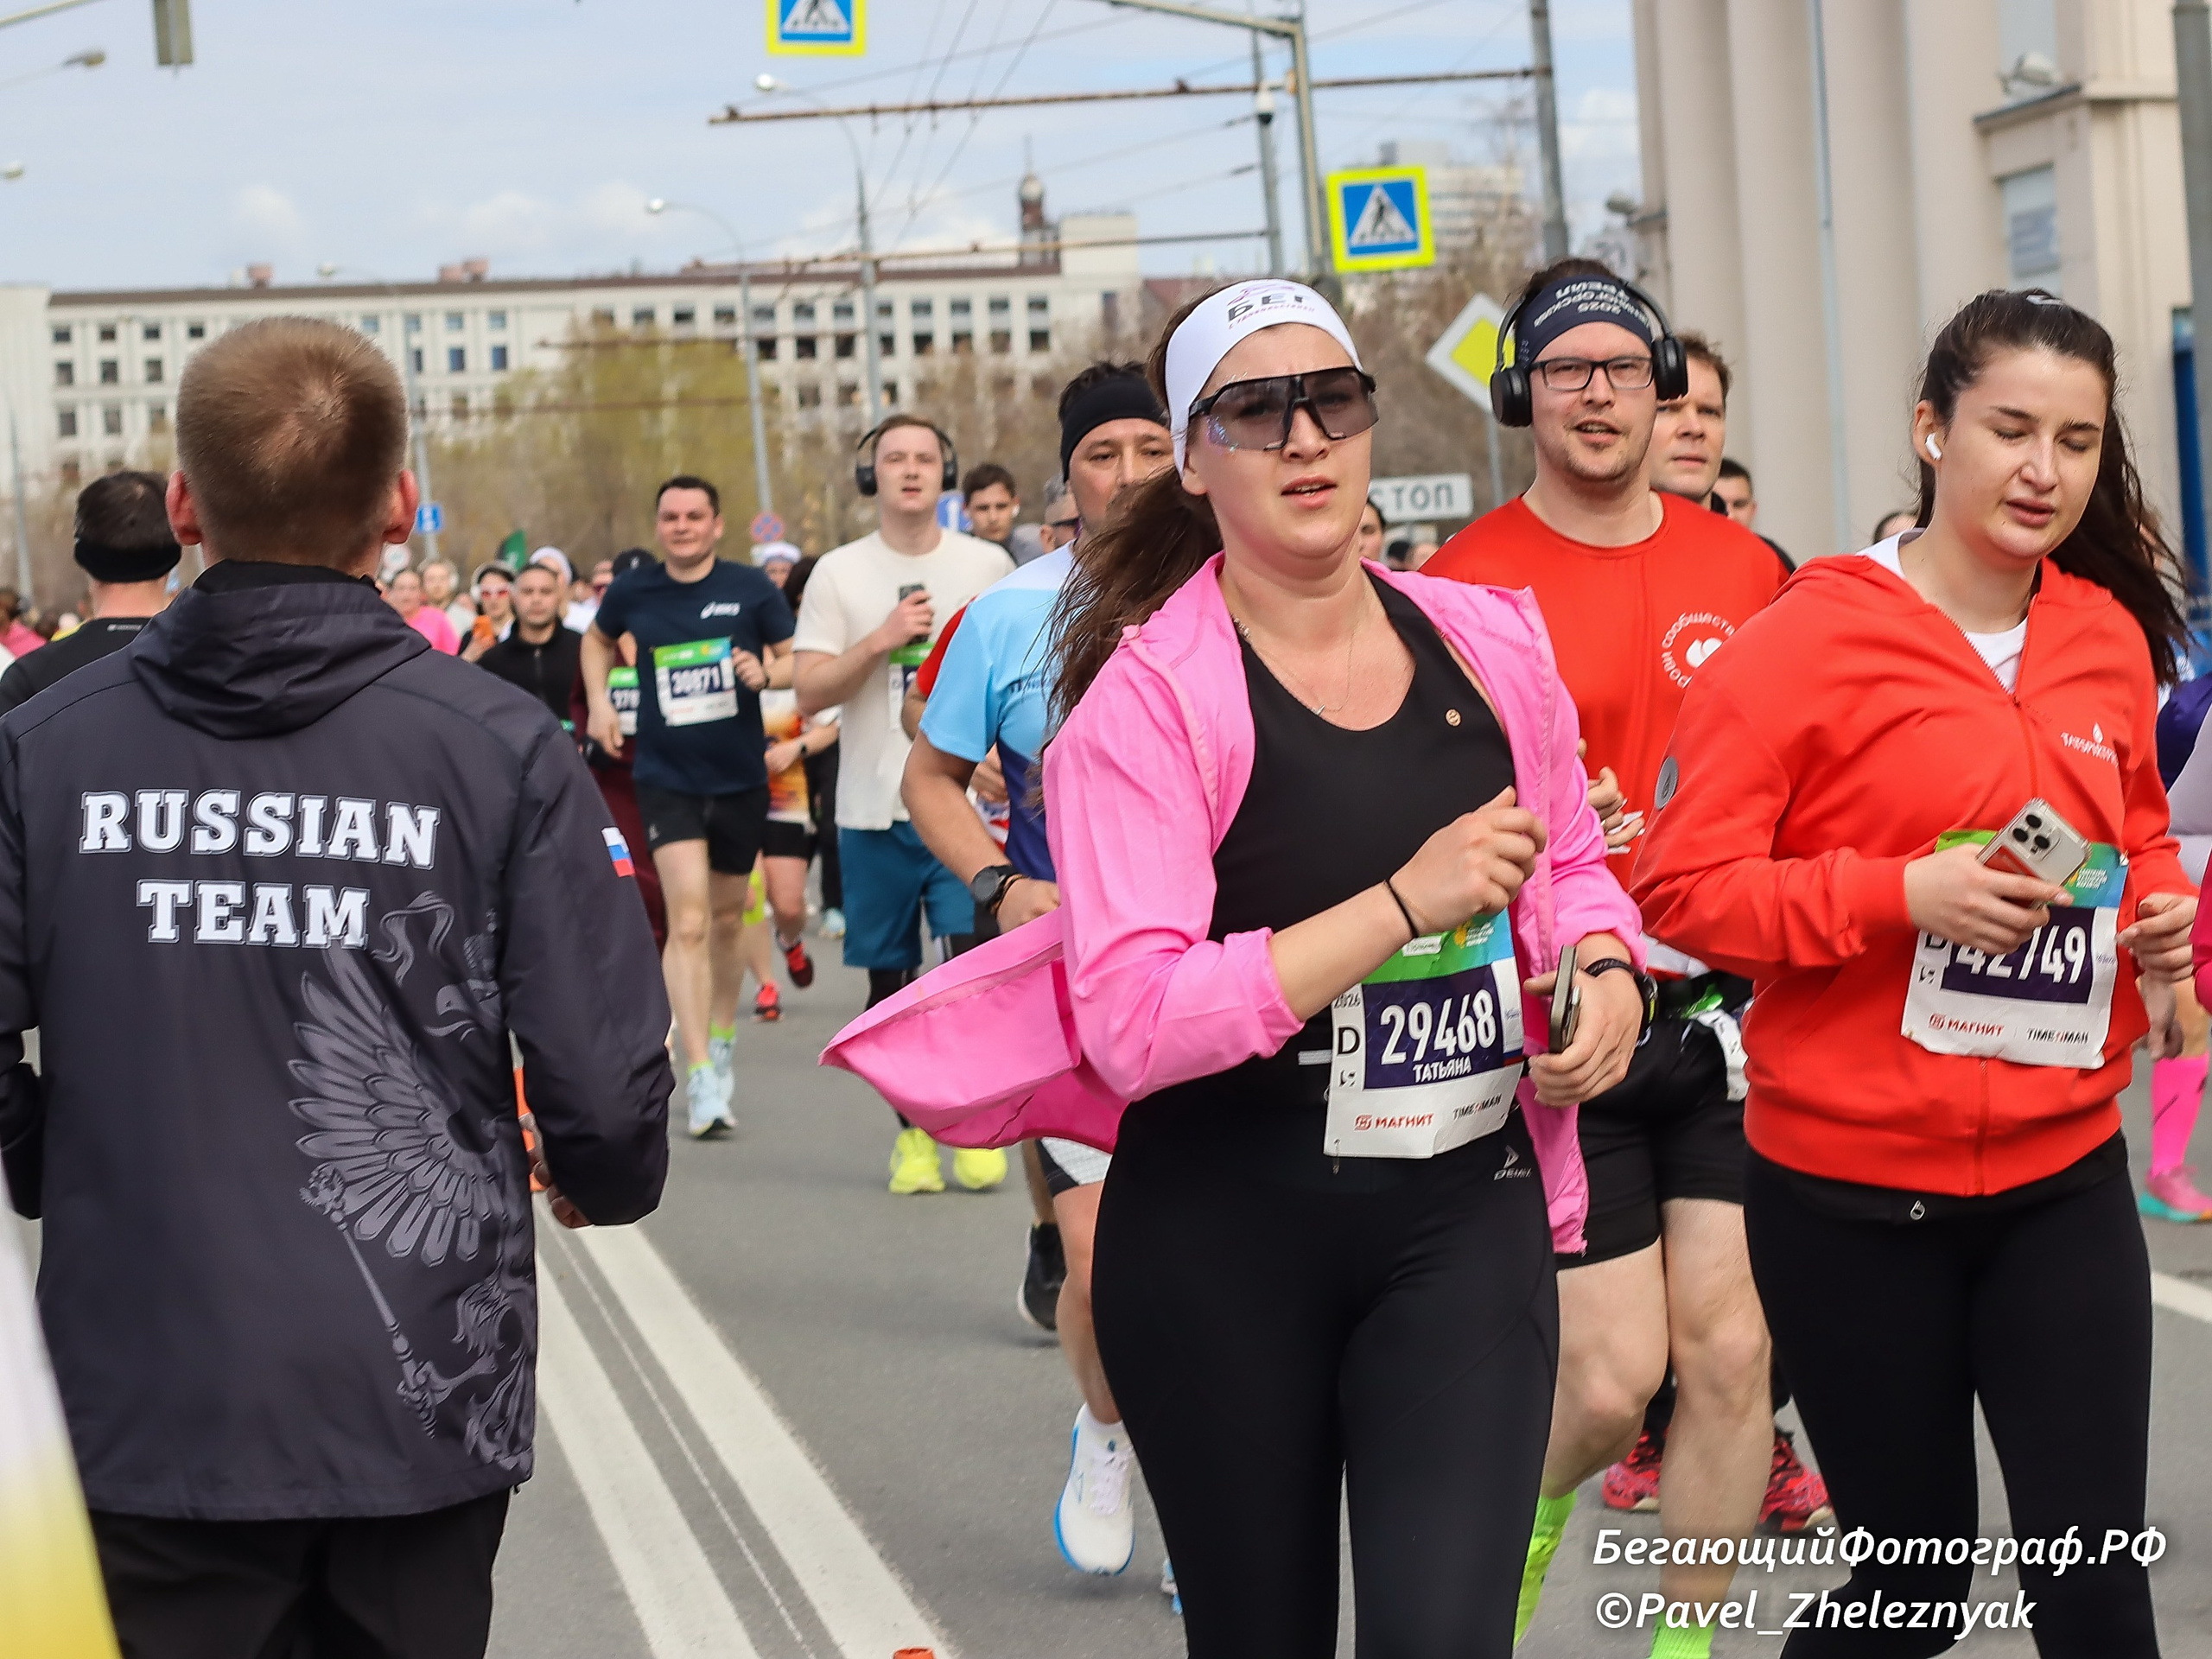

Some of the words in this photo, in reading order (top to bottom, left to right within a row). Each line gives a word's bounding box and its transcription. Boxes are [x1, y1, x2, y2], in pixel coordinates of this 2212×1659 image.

[79, 788, 441, 870] RUSSIAN
[136, 878, 371, 950] TEAM
[1380, 988, 1497, 1065] 29468
[1946, 1017, 2005, 1037] МАГНИТ
[1337, 1027, 1360, 1056] D
[1413, 1056, 1472, 1084] ТАТЬЯНА
[1374, 1113, 1434, 1130] МАГНИТ
